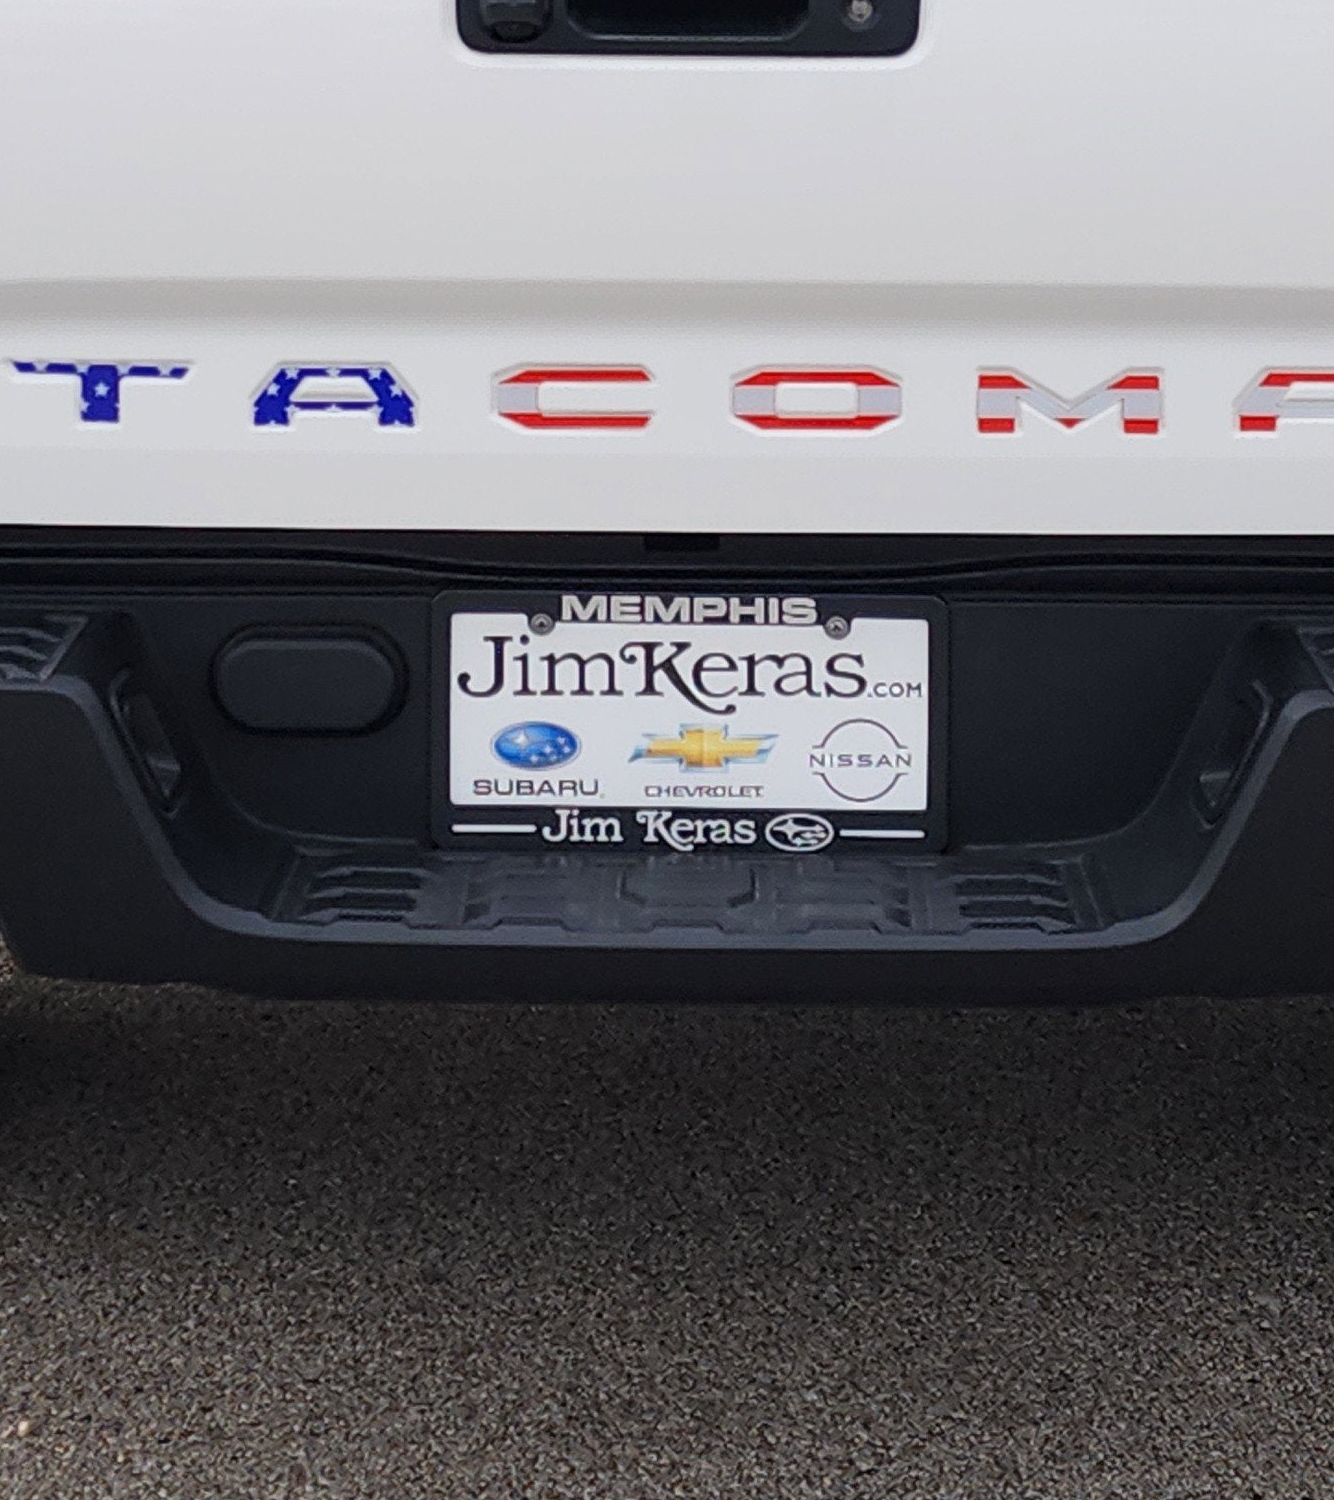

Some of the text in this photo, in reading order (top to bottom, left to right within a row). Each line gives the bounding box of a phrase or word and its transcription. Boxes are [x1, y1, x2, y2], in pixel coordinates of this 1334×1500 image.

[560, 594, 818, 625] MEMPHIS
[810, 752, 912, 769] NISSAN
[473, 778, 600, 798] SUBARU
[644, 784, 765, 799] CHEVROLET
[542, 809, 757, 852] Jim Keras
